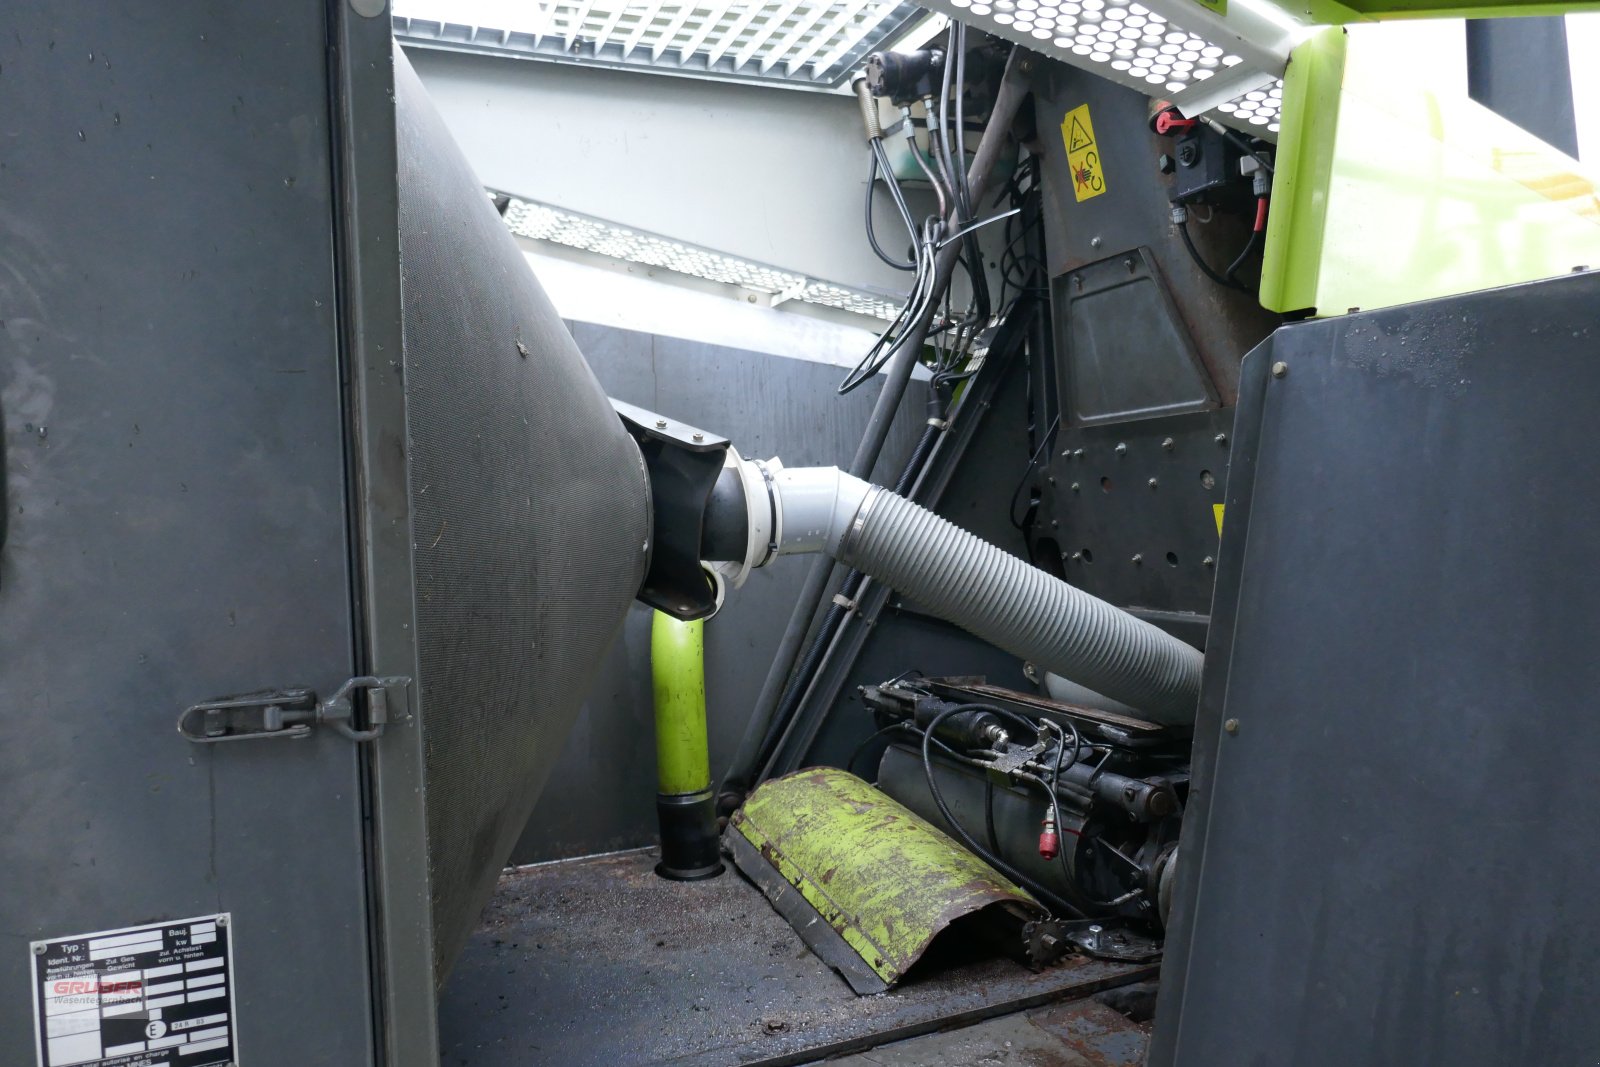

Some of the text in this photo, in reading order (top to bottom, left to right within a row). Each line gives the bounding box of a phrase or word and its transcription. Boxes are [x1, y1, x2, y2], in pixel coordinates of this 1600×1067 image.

[61, 944, 79, 953] Typ
[184, 951, 204, 959] hinten
[107, 962, 136, 972] Gewicht
